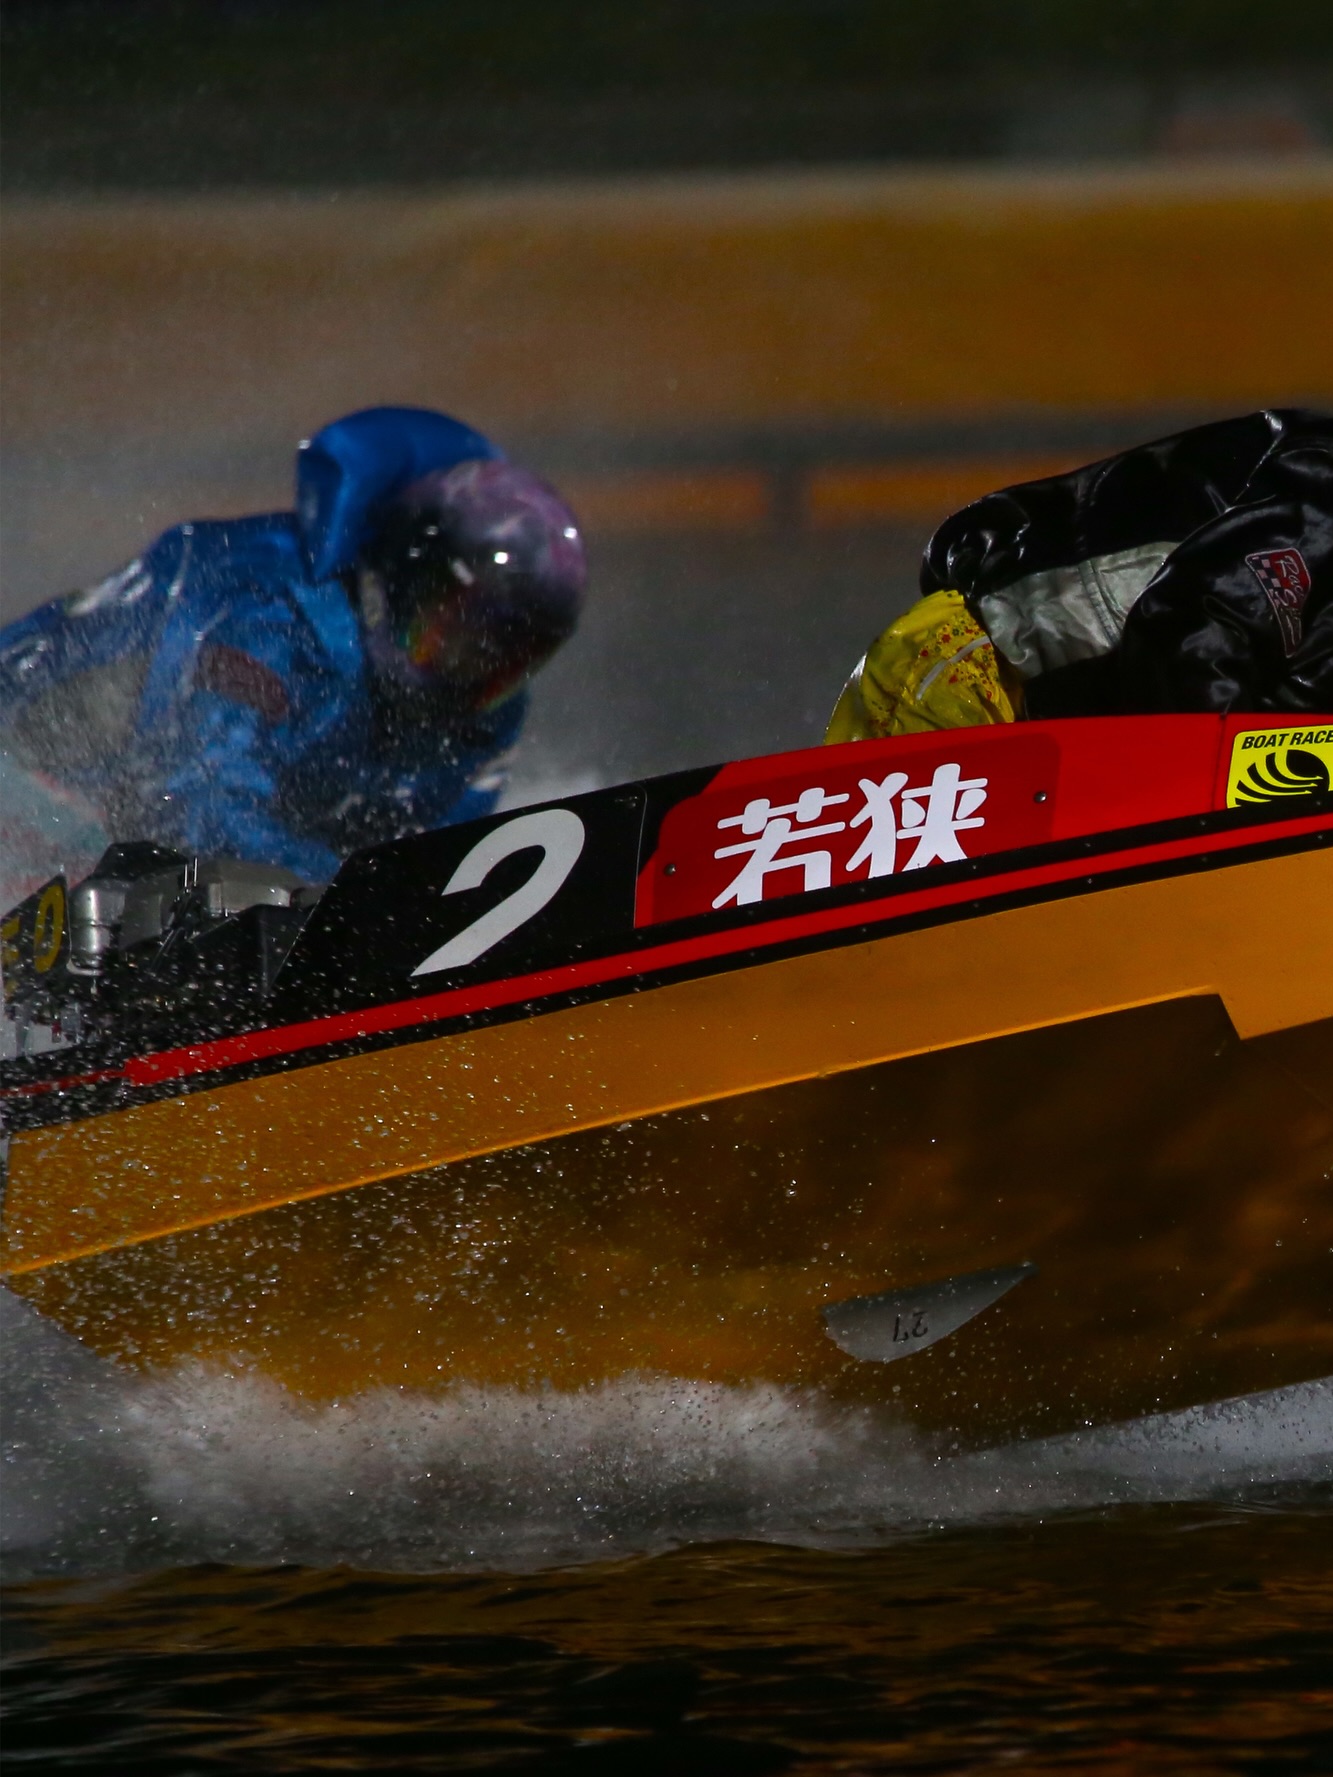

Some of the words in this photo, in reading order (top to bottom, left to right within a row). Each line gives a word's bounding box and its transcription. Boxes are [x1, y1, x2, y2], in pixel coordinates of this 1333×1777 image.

[1241, 733, 1290, 750] BOAT
[410, 808, 586, 977] 2
[711, 762, 989, 910] 若狭
